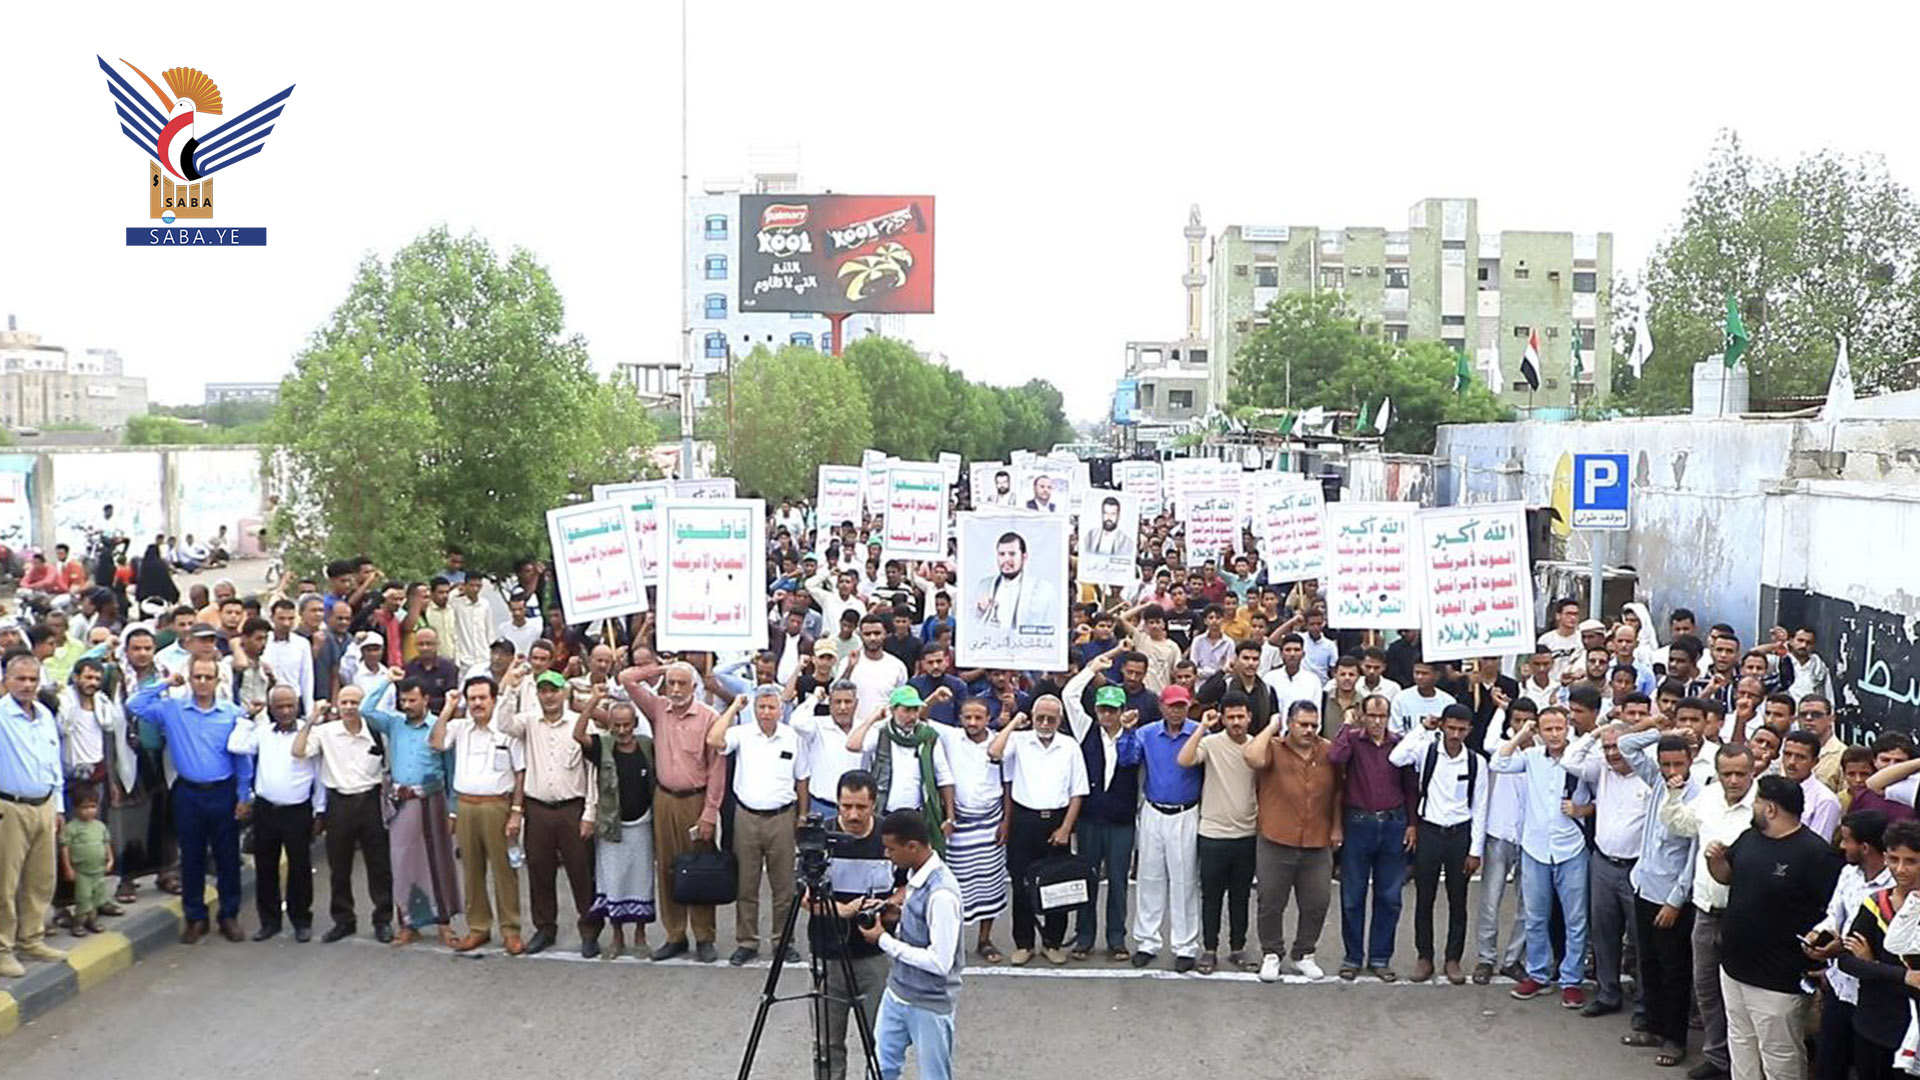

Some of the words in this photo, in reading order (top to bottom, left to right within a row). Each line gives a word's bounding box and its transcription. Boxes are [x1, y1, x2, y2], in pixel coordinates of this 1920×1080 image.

[756, 230, 812, 252] KOOL
[1584, 459, 1619, 504] P
[1218, 498, 1234, 510] الله
[1267, 494, 1295, 515] أكبر
[1298, 493, 1316, 507] الله
[1339, 516, 1377, 540] أكبر
[1380, 517, 1405, 534] الله
[1600, 514, 1623, 524] موقف
[673, 518, 746, 545] قاطعوا
[1432, 519, 1480, 551] أكبر
[1483, 520, 1514, 541] الله
[1480, 550, 1515, 569] الموت
[1481, 573, 1517, 592] الموت
[1470, 598, 1486, 615] على
[1484, 617, 1521, 644] النصر
